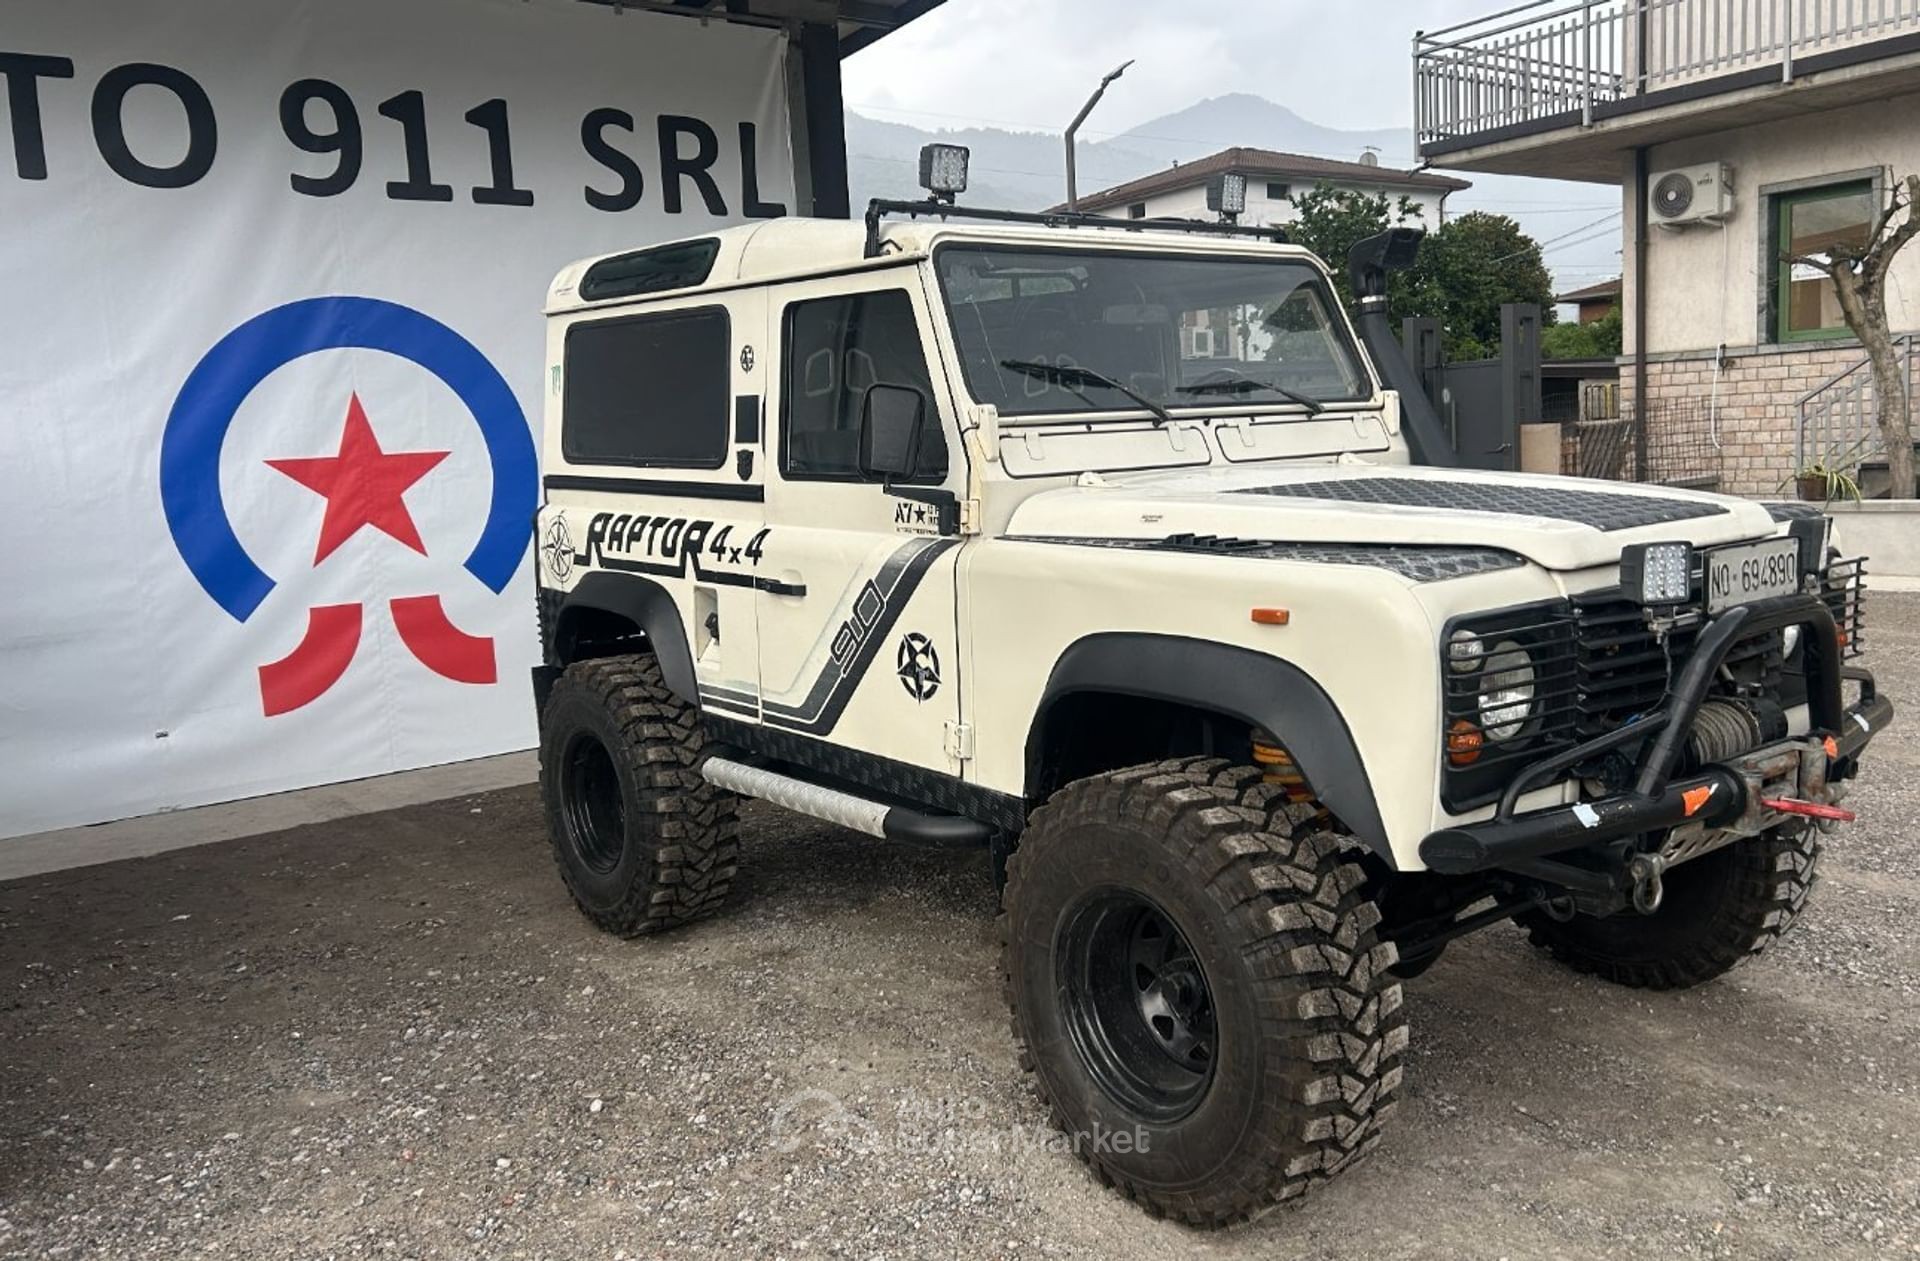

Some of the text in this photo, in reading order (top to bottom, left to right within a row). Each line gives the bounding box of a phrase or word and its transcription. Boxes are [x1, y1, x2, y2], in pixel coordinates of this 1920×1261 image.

[0, 52, 787, 218] TO 911 SRL
[585, 512, 772, 580] RAPTOR 4x4
[1741, 552, 1796, 592] 694890
